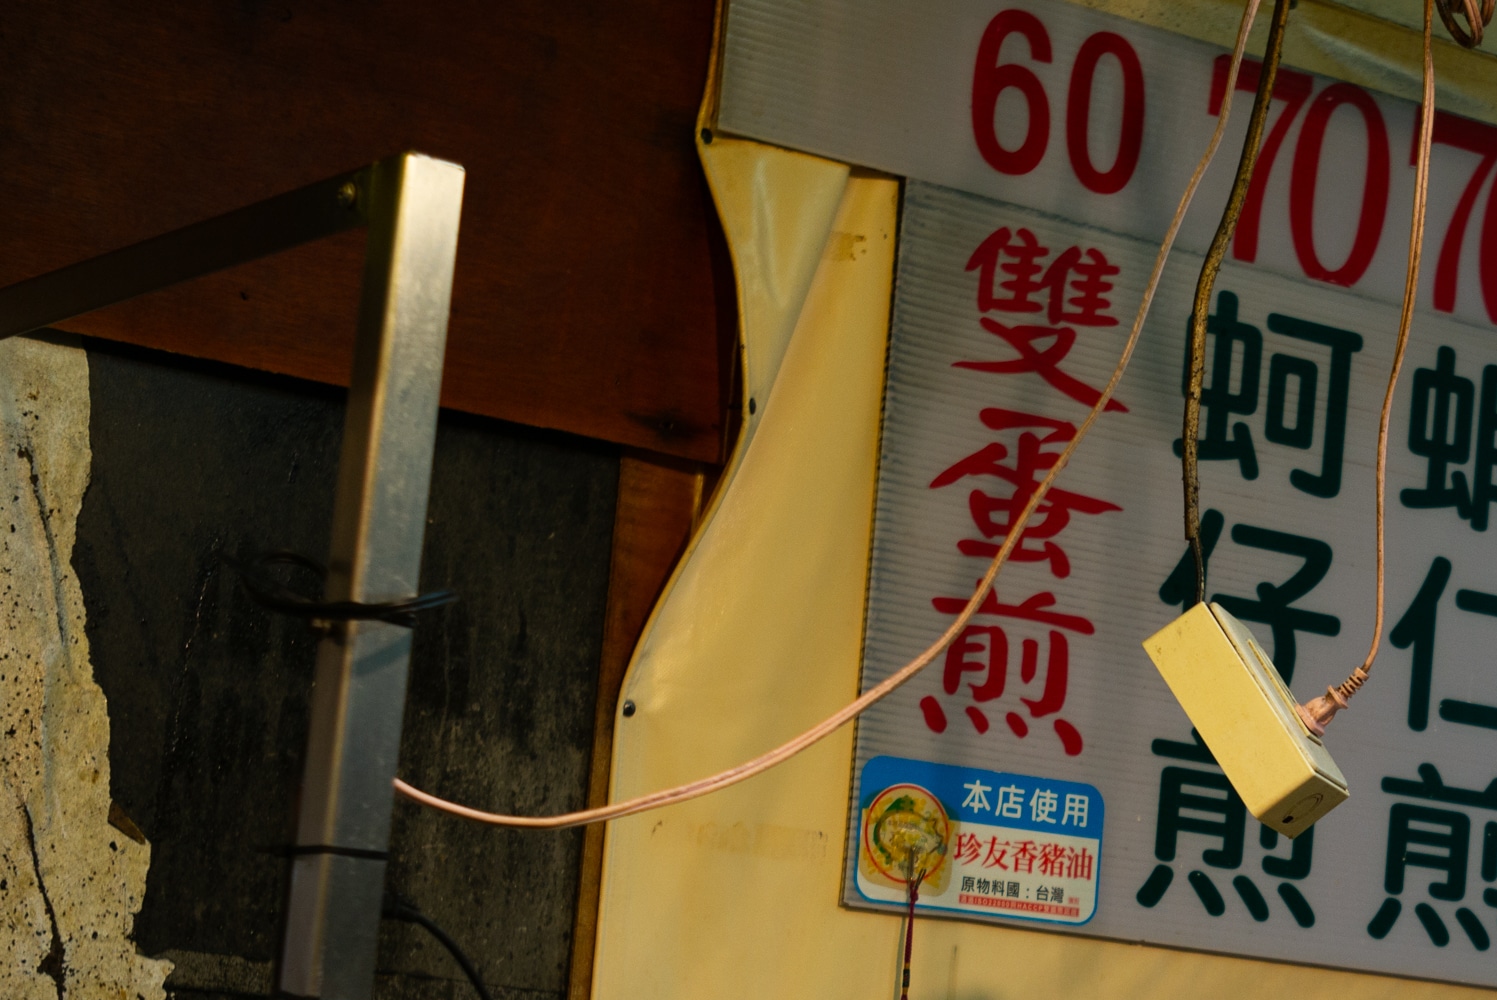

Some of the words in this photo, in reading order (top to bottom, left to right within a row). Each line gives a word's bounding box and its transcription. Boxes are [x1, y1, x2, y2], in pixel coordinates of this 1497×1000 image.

[971, 9, 1145, 194] 60
[1208, 53, 1390, 288] 70
[919, 226, 1129, 757] 雙蛋煎
[1136, 290, 1363, 928] 蚵仔煎
[953, 832, 1094, 881] 珍友香豬油
[961, 780, 1090, 828] 本店使用
